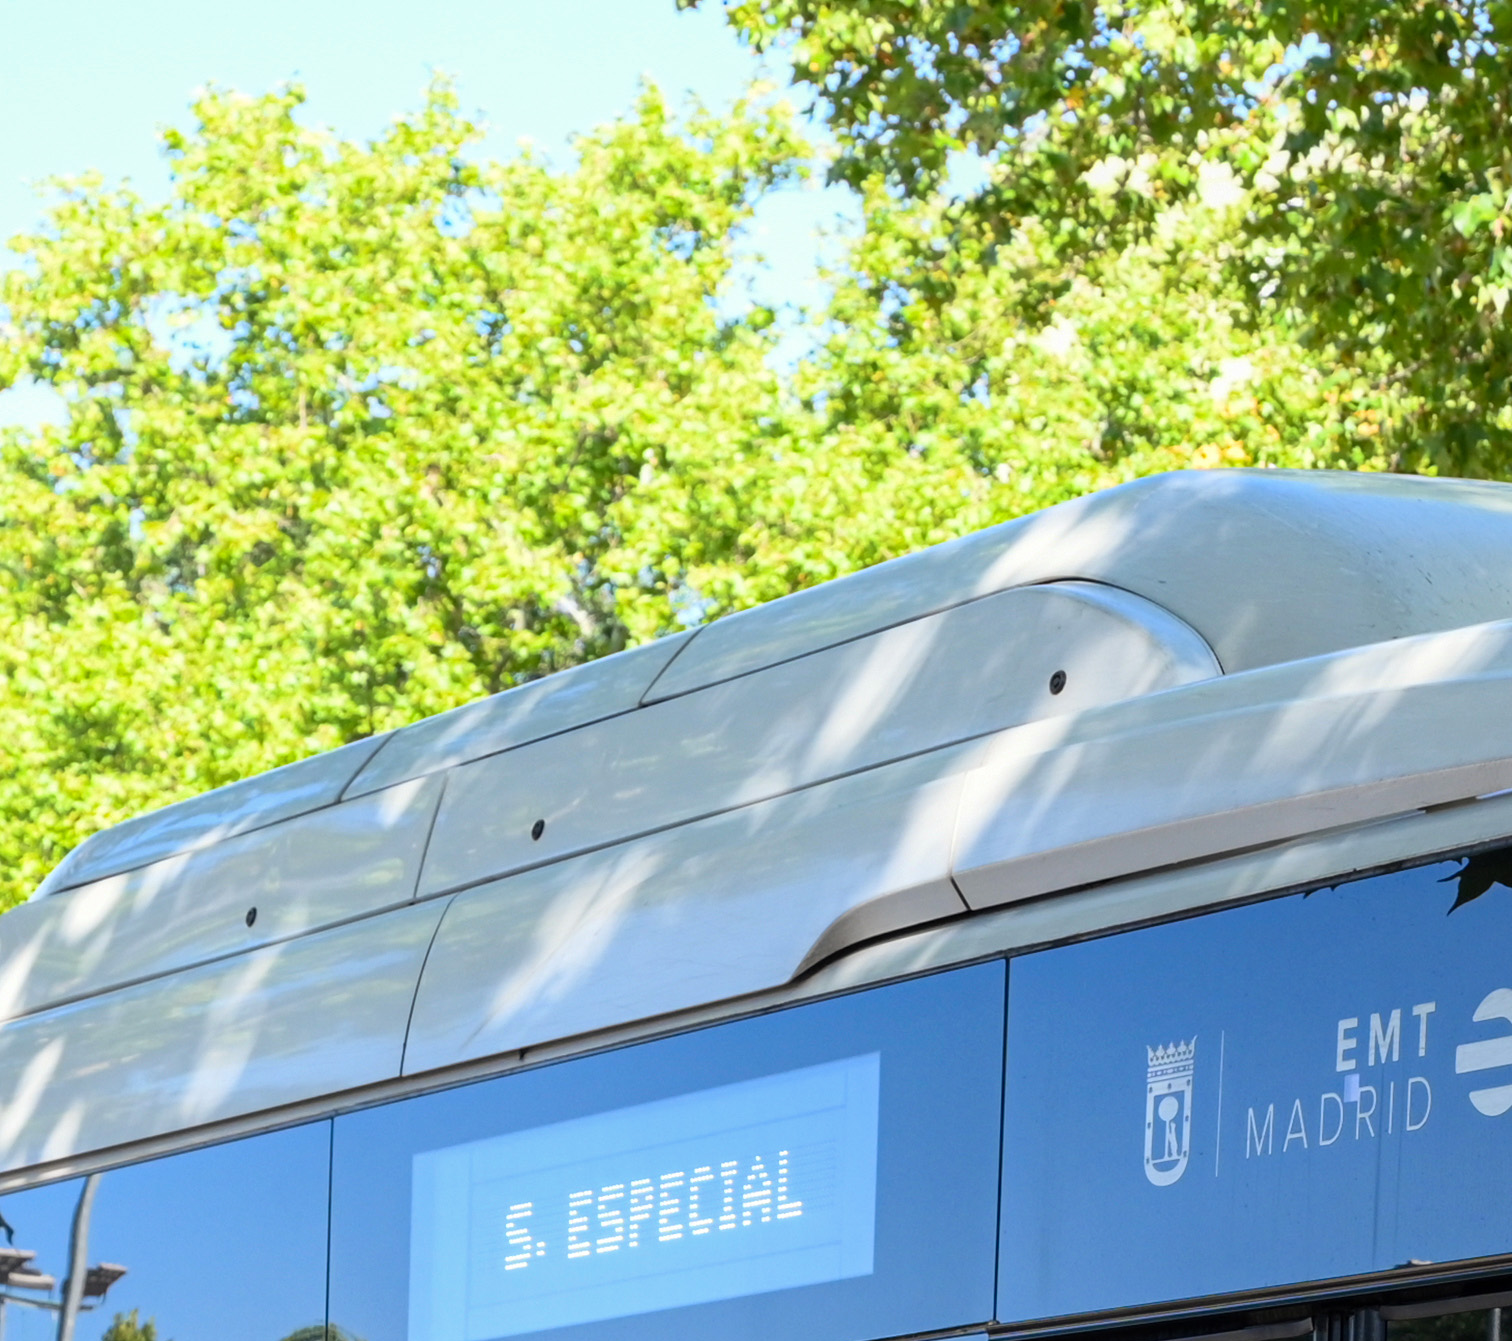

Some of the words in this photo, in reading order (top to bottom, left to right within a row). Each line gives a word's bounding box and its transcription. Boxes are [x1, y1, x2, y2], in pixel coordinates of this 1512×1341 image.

[1335, 1000, 1438, 1072] EMT
[1244, 1076, 1433, 1160] MADRID
[504, 1199, 548, 1271] S.
[566, 1147, 805, 1262] ESPECIAL
